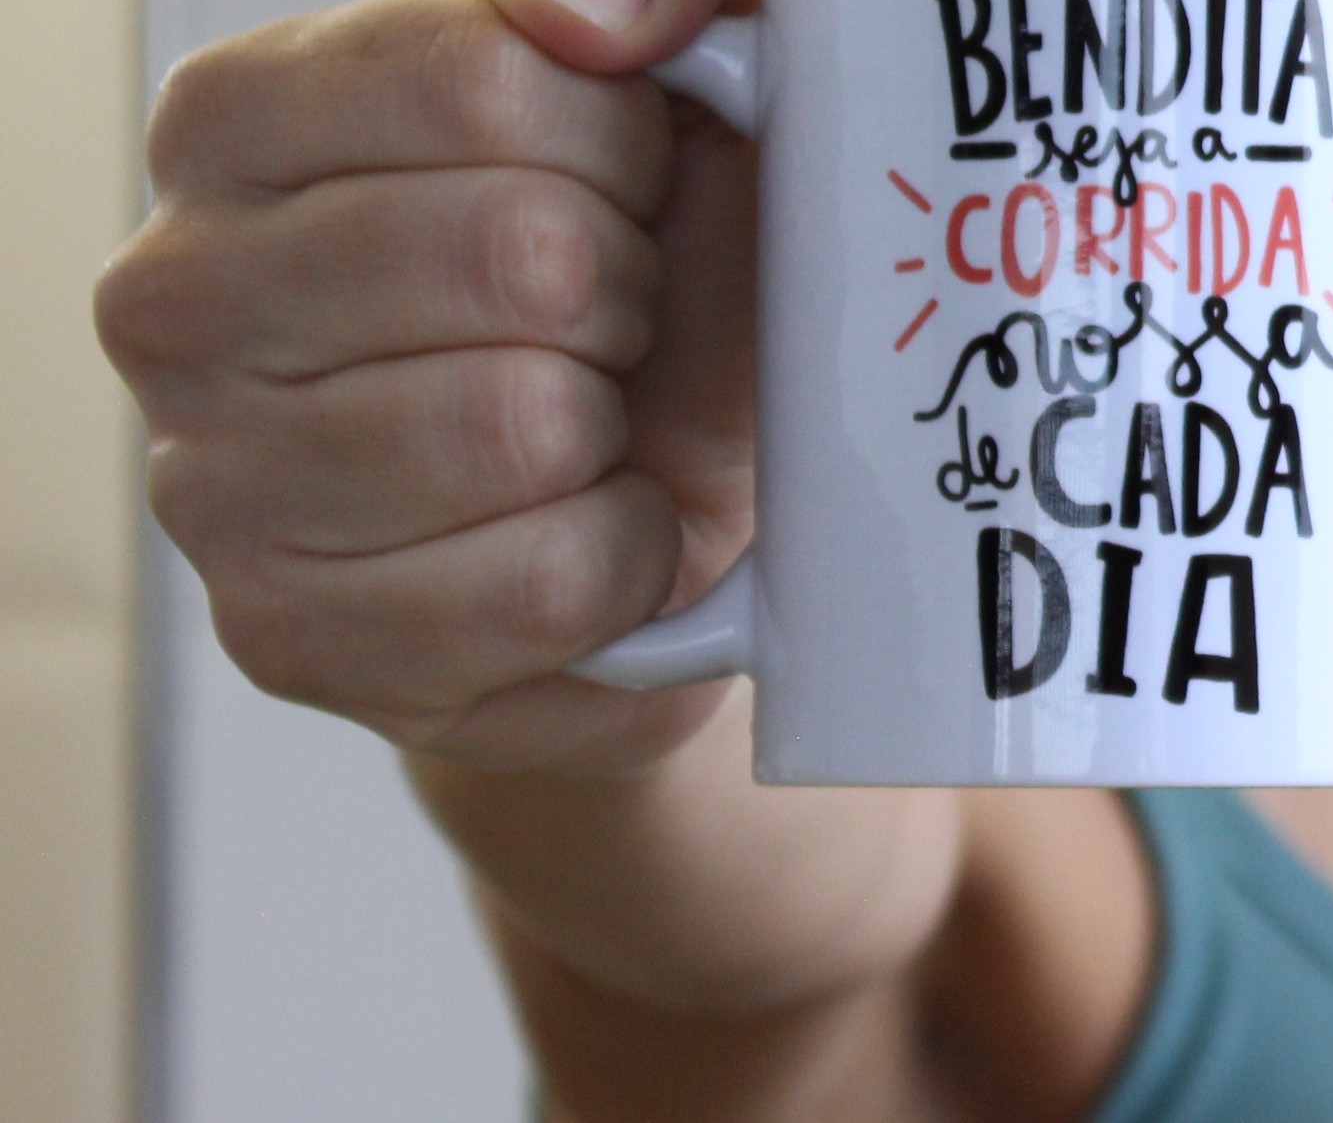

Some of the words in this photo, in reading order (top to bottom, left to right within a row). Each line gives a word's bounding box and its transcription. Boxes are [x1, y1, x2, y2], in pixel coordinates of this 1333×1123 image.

[1024, 120, 1177, 206] seja
[1192, 127, 1238, 162] a
[945, 182, 1310, 298] CORRIDA
[936, 405, 1020, 502] de
[1029, 396, 1314, 539] CADA
[976, 527, 1260, 715] DIA
